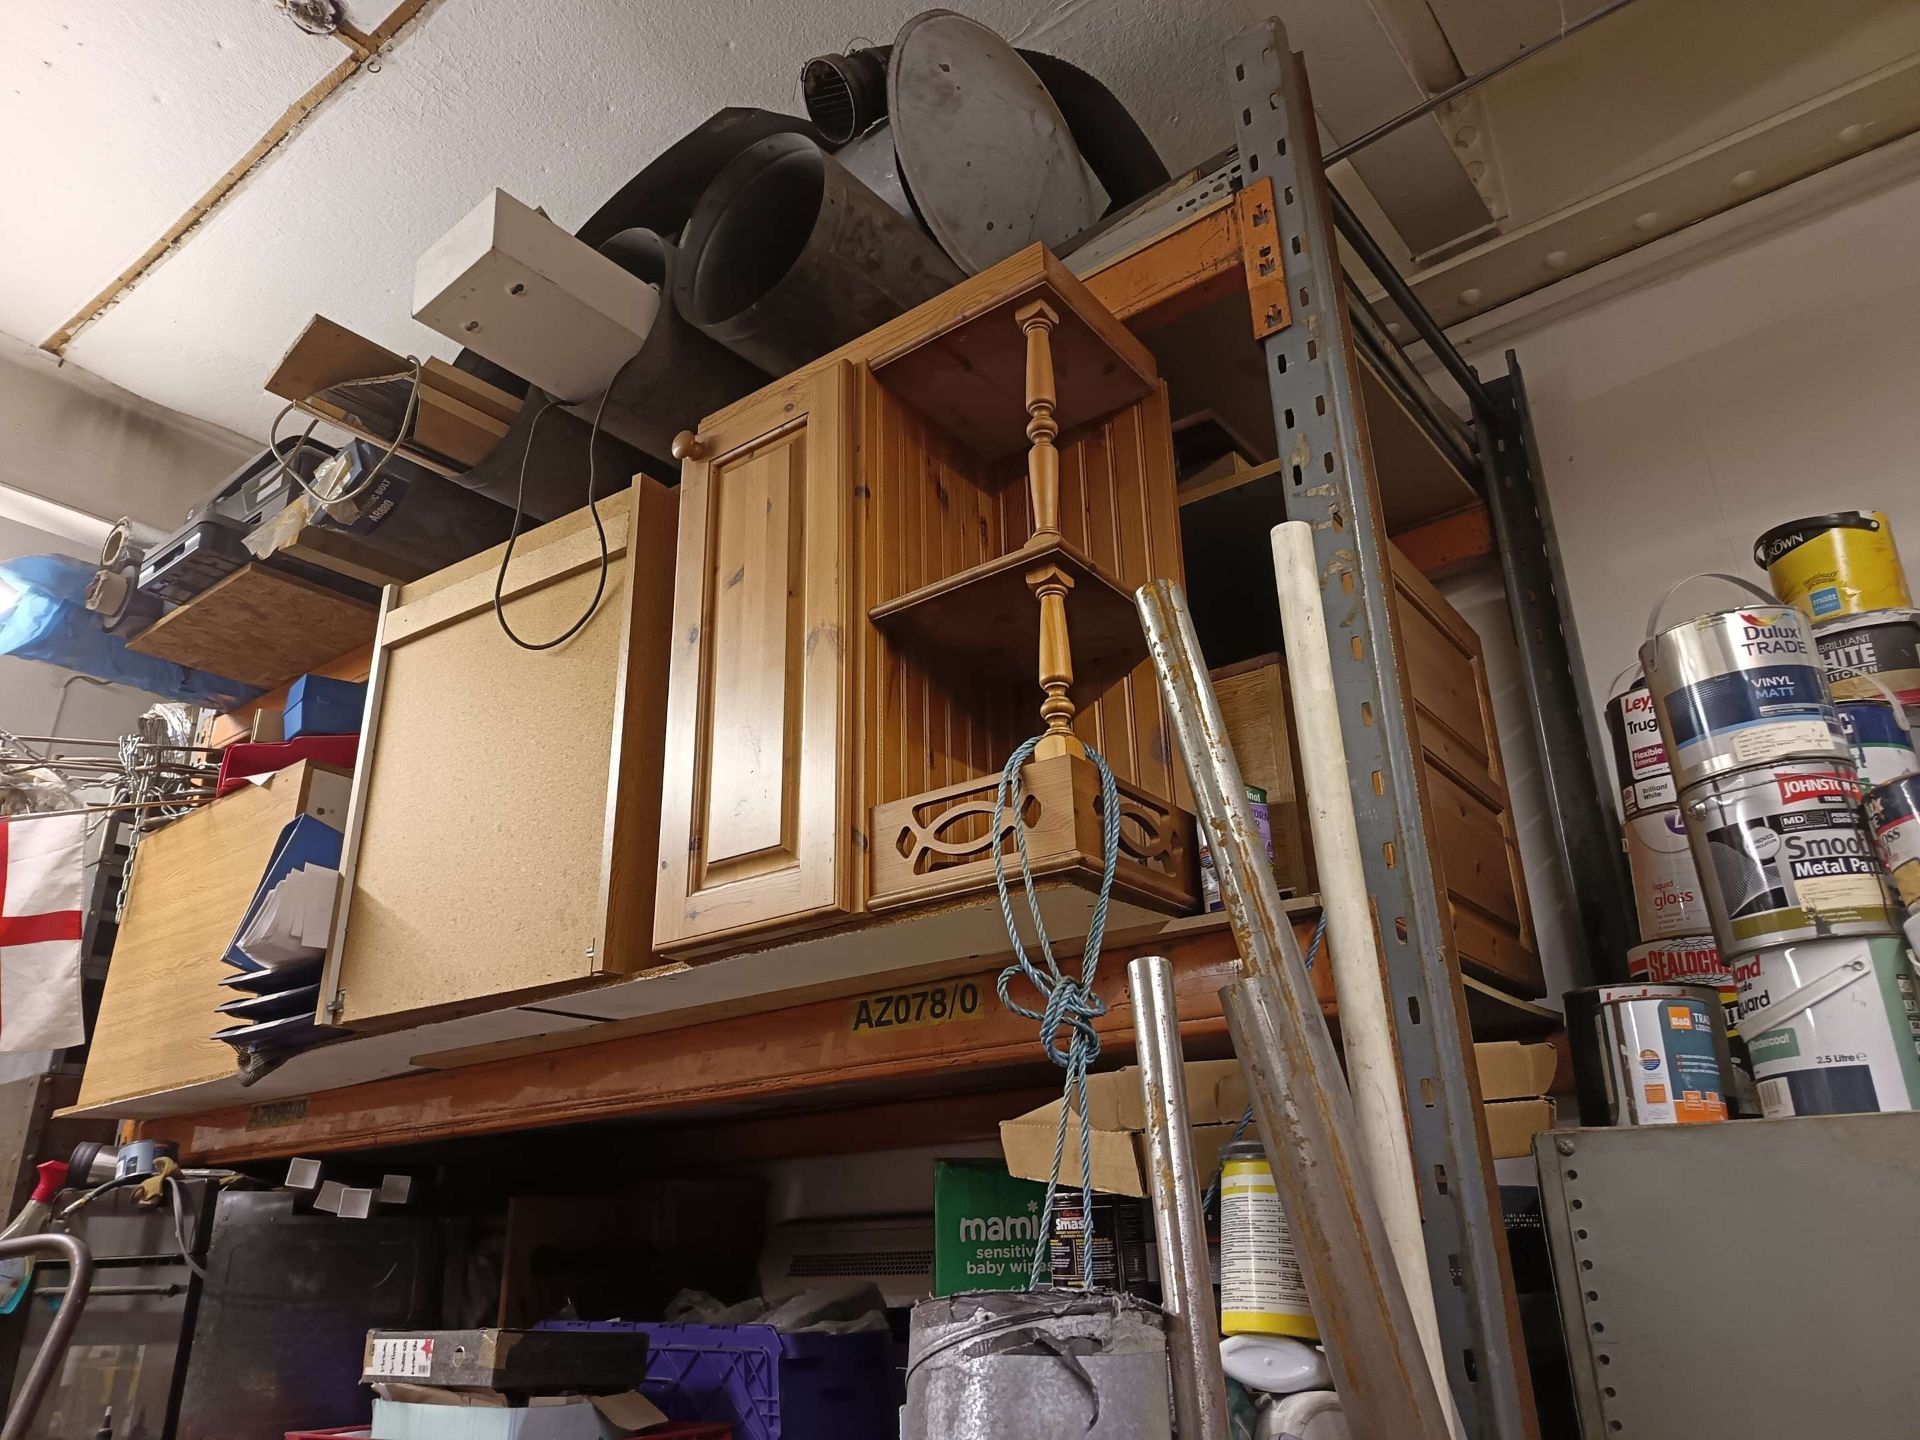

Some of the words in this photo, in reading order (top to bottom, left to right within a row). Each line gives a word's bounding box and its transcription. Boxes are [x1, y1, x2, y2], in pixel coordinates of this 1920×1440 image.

[1743, 625, 1798, 640] Dulux
[1741, 640, 1808, 656] TRADE
[1819, 634, 1871, 654] BRILLIANT
[1823, 642, 1877, 672] HITE
[1751, 675, 1795, 688] VINYL
[1755, 686, 1794, 699] MATT
[1642, 783, 1668, 794] Brilliant
[1643, 791, 1662, 801] White
[1794, 857, 1847, 877] Metal
[1654, 891, 1694, 911] gloss
[853, 983, 977, 1030] AZ078/0
[1816, 1055, 1832, 1065] 2.5
[1834, 1053, 1855, 1063] Litre
[959, 1214, 1050, 1243] mami
[976, 1244, 1039, 1260] sensitiv
[966, 1261, 1005, 1276] baby
